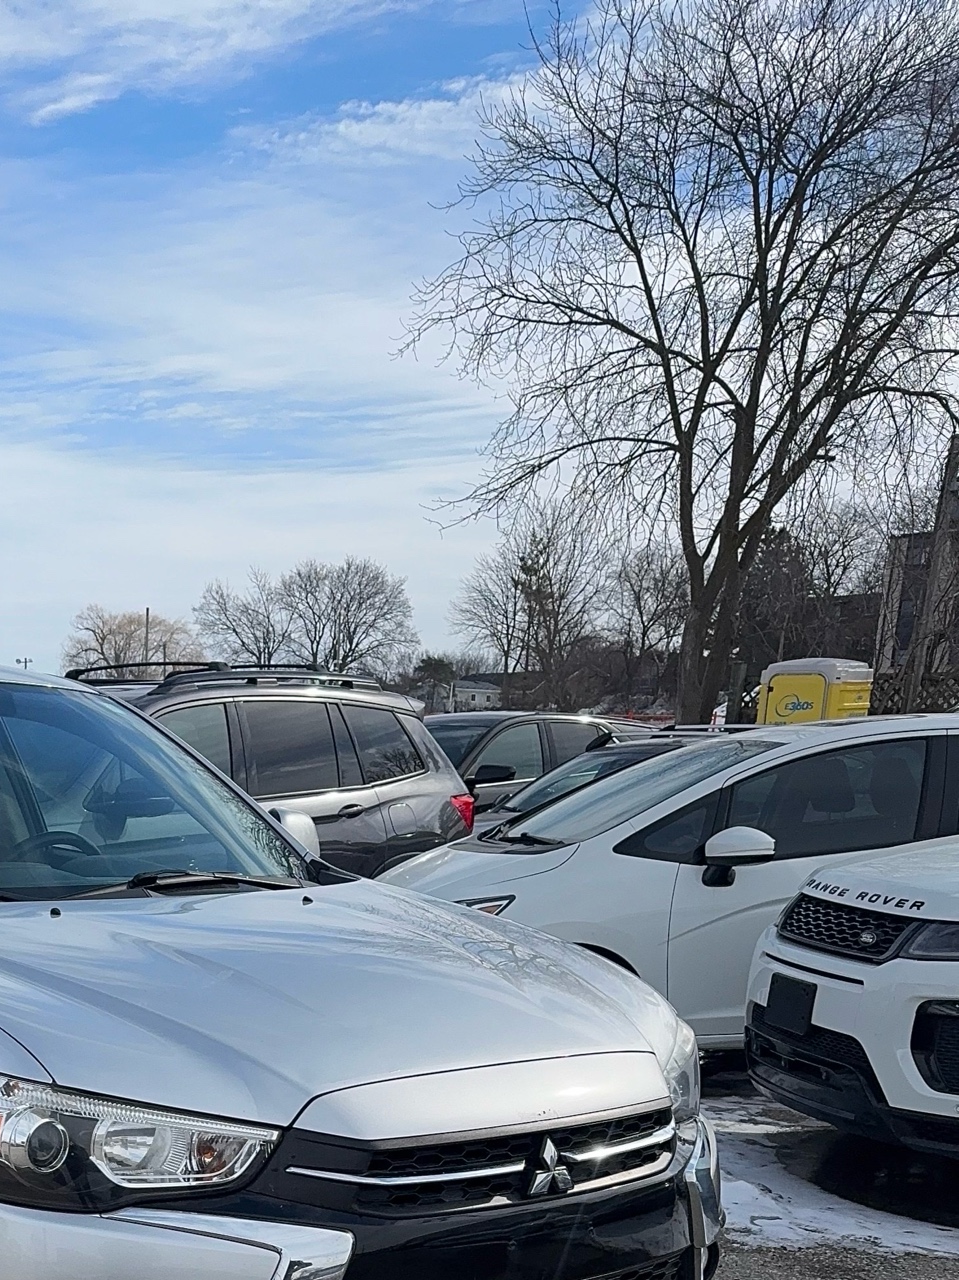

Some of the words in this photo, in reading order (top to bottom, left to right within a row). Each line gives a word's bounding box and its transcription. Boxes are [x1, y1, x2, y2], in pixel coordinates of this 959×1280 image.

[784, 701, 814, 711] E360S
[806, 878, 850, 898] RANGE
[855, 891, 926, 911] ROVER
